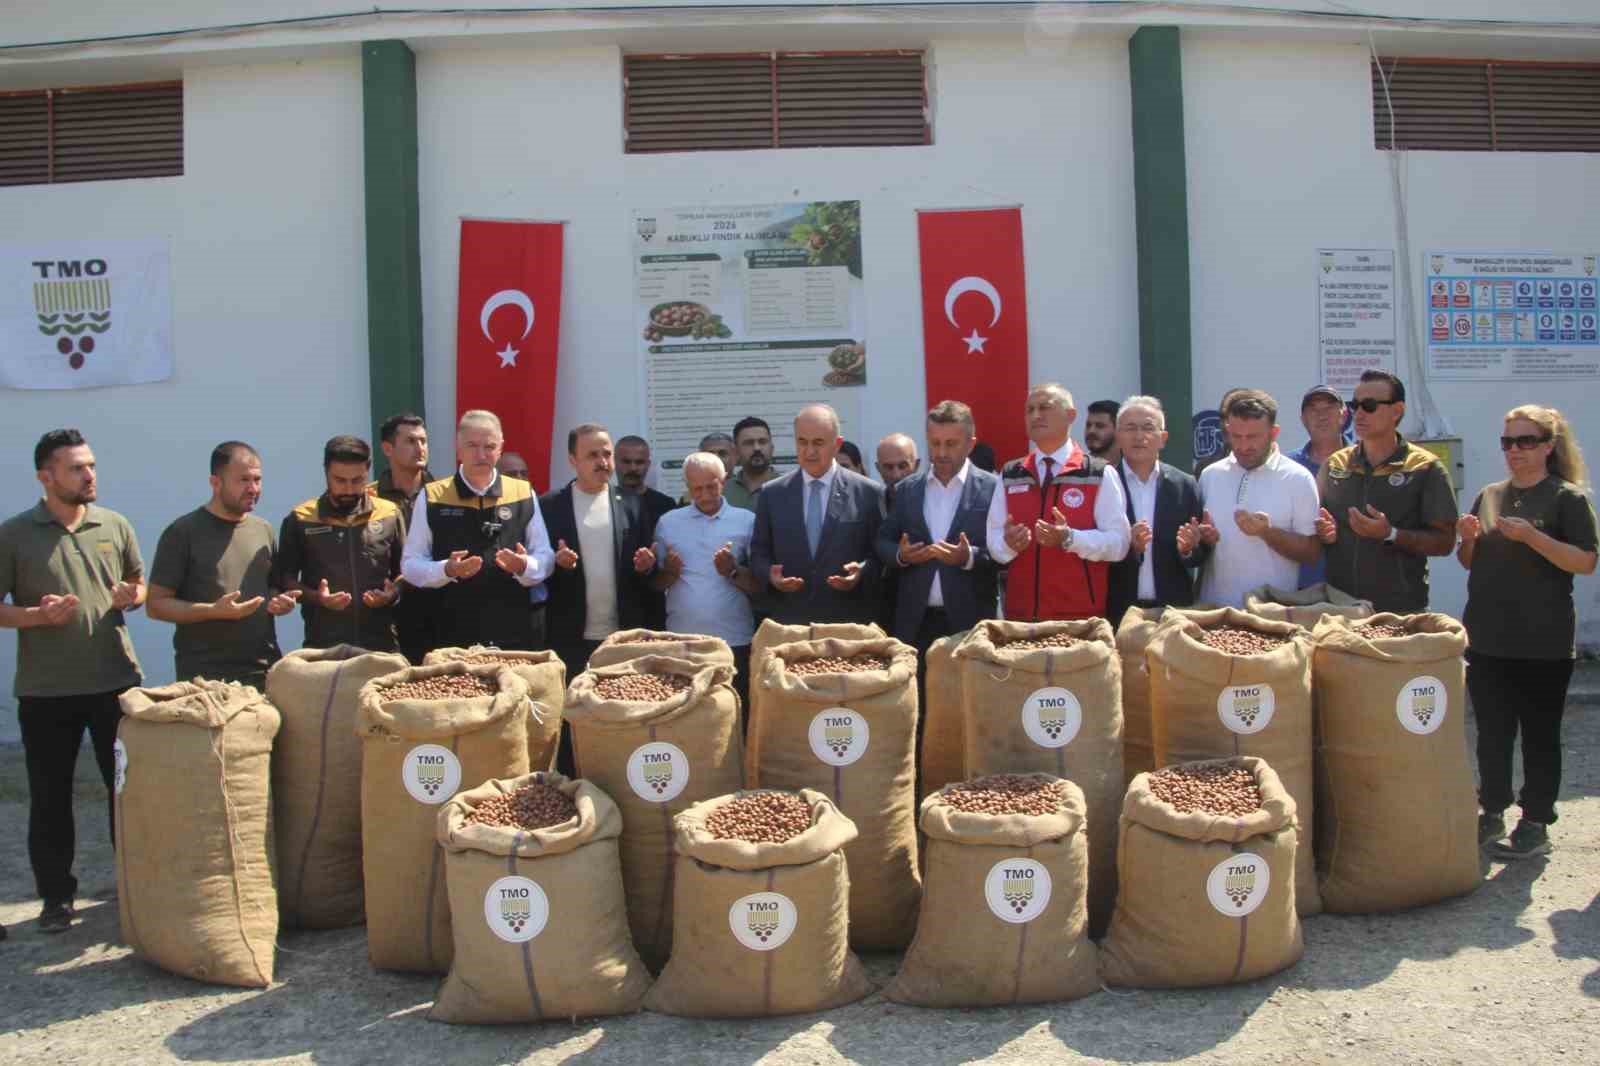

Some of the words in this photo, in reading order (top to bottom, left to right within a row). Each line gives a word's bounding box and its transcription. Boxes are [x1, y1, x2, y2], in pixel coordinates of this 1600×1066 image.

[32, 259, 107, 278] TMO
[1234, 687, 1260, 698] TMO
[1411, 685, 1436, 697] TMO
[1038, 697, 1066, 708] TMO
[824, 716, 852, 727] TMO
[417, 755, 445, 765] TMO
[643, 753, 672, 763] TMO
[1004, 868, 1035, 880] TMO
[1228, 864, 1256, 876] TMO
[500, 888, 529, 899] TMO
[747, 901, 779, 912] TMO
